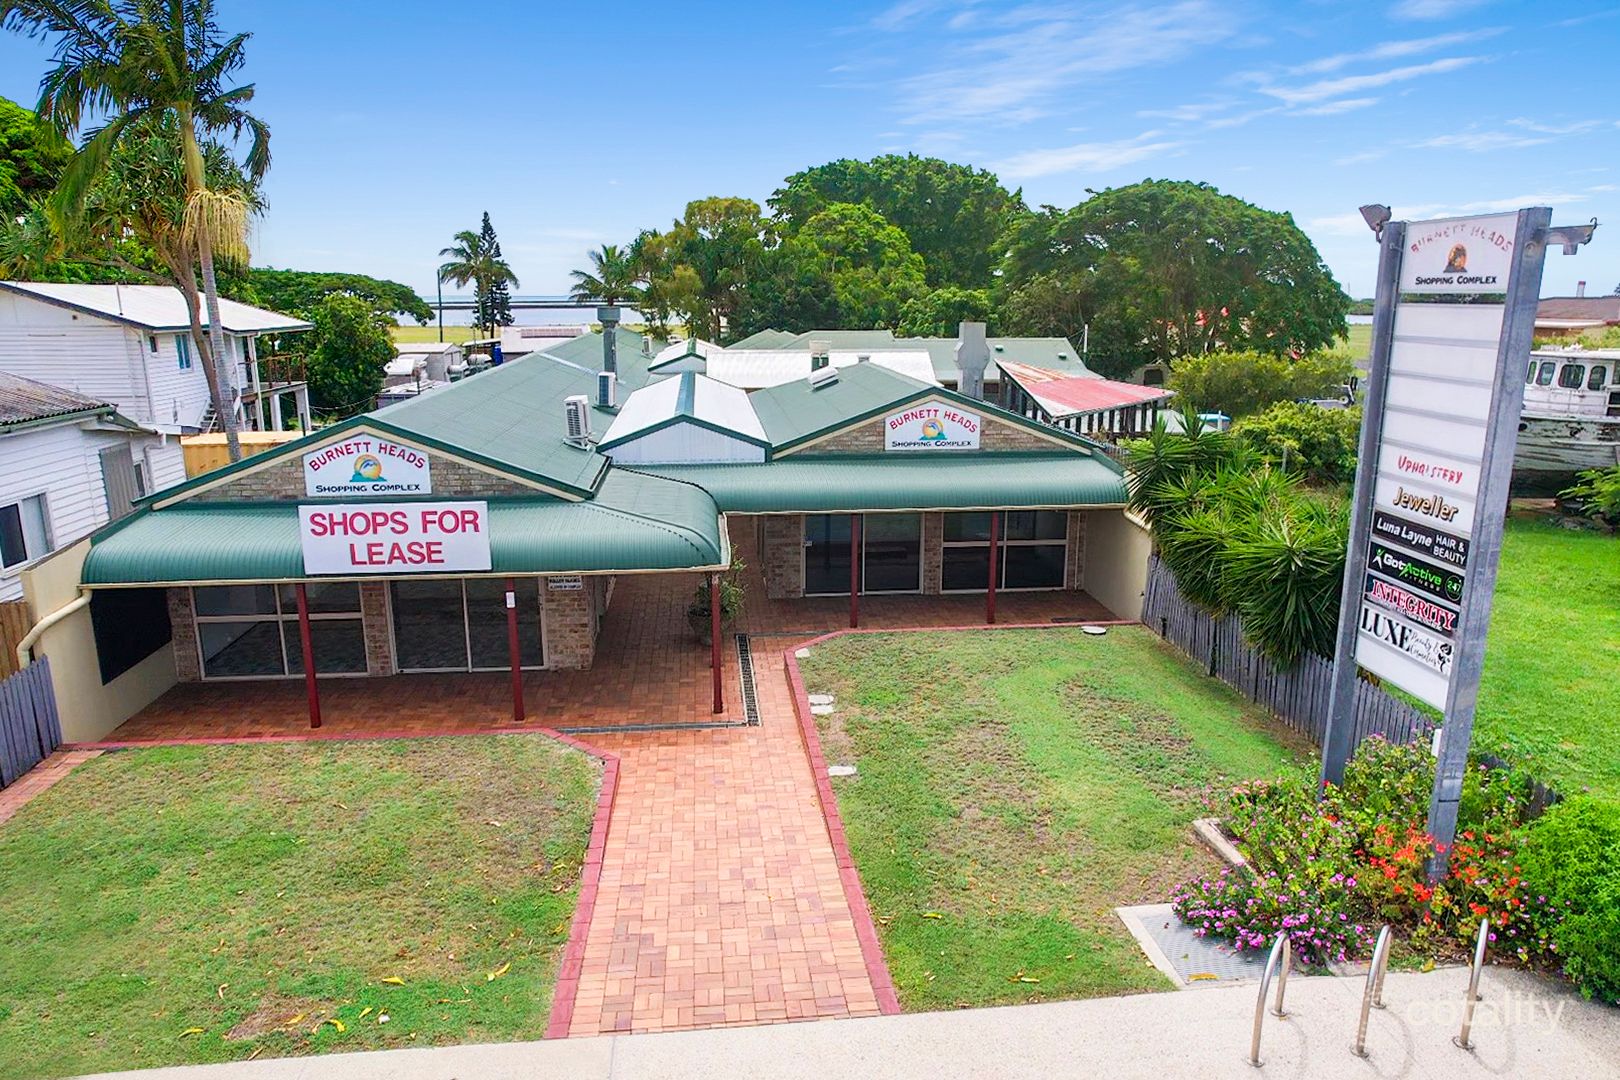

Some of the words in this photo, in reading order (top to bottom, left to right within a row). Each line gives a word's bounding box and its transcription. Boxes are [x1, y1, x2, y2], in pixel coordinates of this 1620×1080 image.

[1415, 276, 1454, 285] SHOPPING
[1457, 275, 1497, 285] COMPLEX
[889, 409, 939, 430] BURNETT
[944, 410, 977, 433] HEADS
[309, 442, 371, 472] BURNETT
[379, 443, 426, 469] HEADS
[315, 484, 367, 493] SHOPPING
[372, 484, 421, 492] COMPLEX
[1393, 487, 1459, 522] Jeweller
[309, 511, 409, 536] SHOPS
[421, 510, 480, 534] FOR
[1376, 518, 1400, 536] Luna
[1401, 525, 1432, 547] Layne
[350, 541, 445, 566] LEASE
[1433, 545, 1466, 565] BEAUTY
[1435, 534, 1456, 549] HAIR
[1458, 542, 1465, 553] &
[1372, 578, 1456, 631] INTEGRITY
[1361, 607, 1412, 653] LUXE
